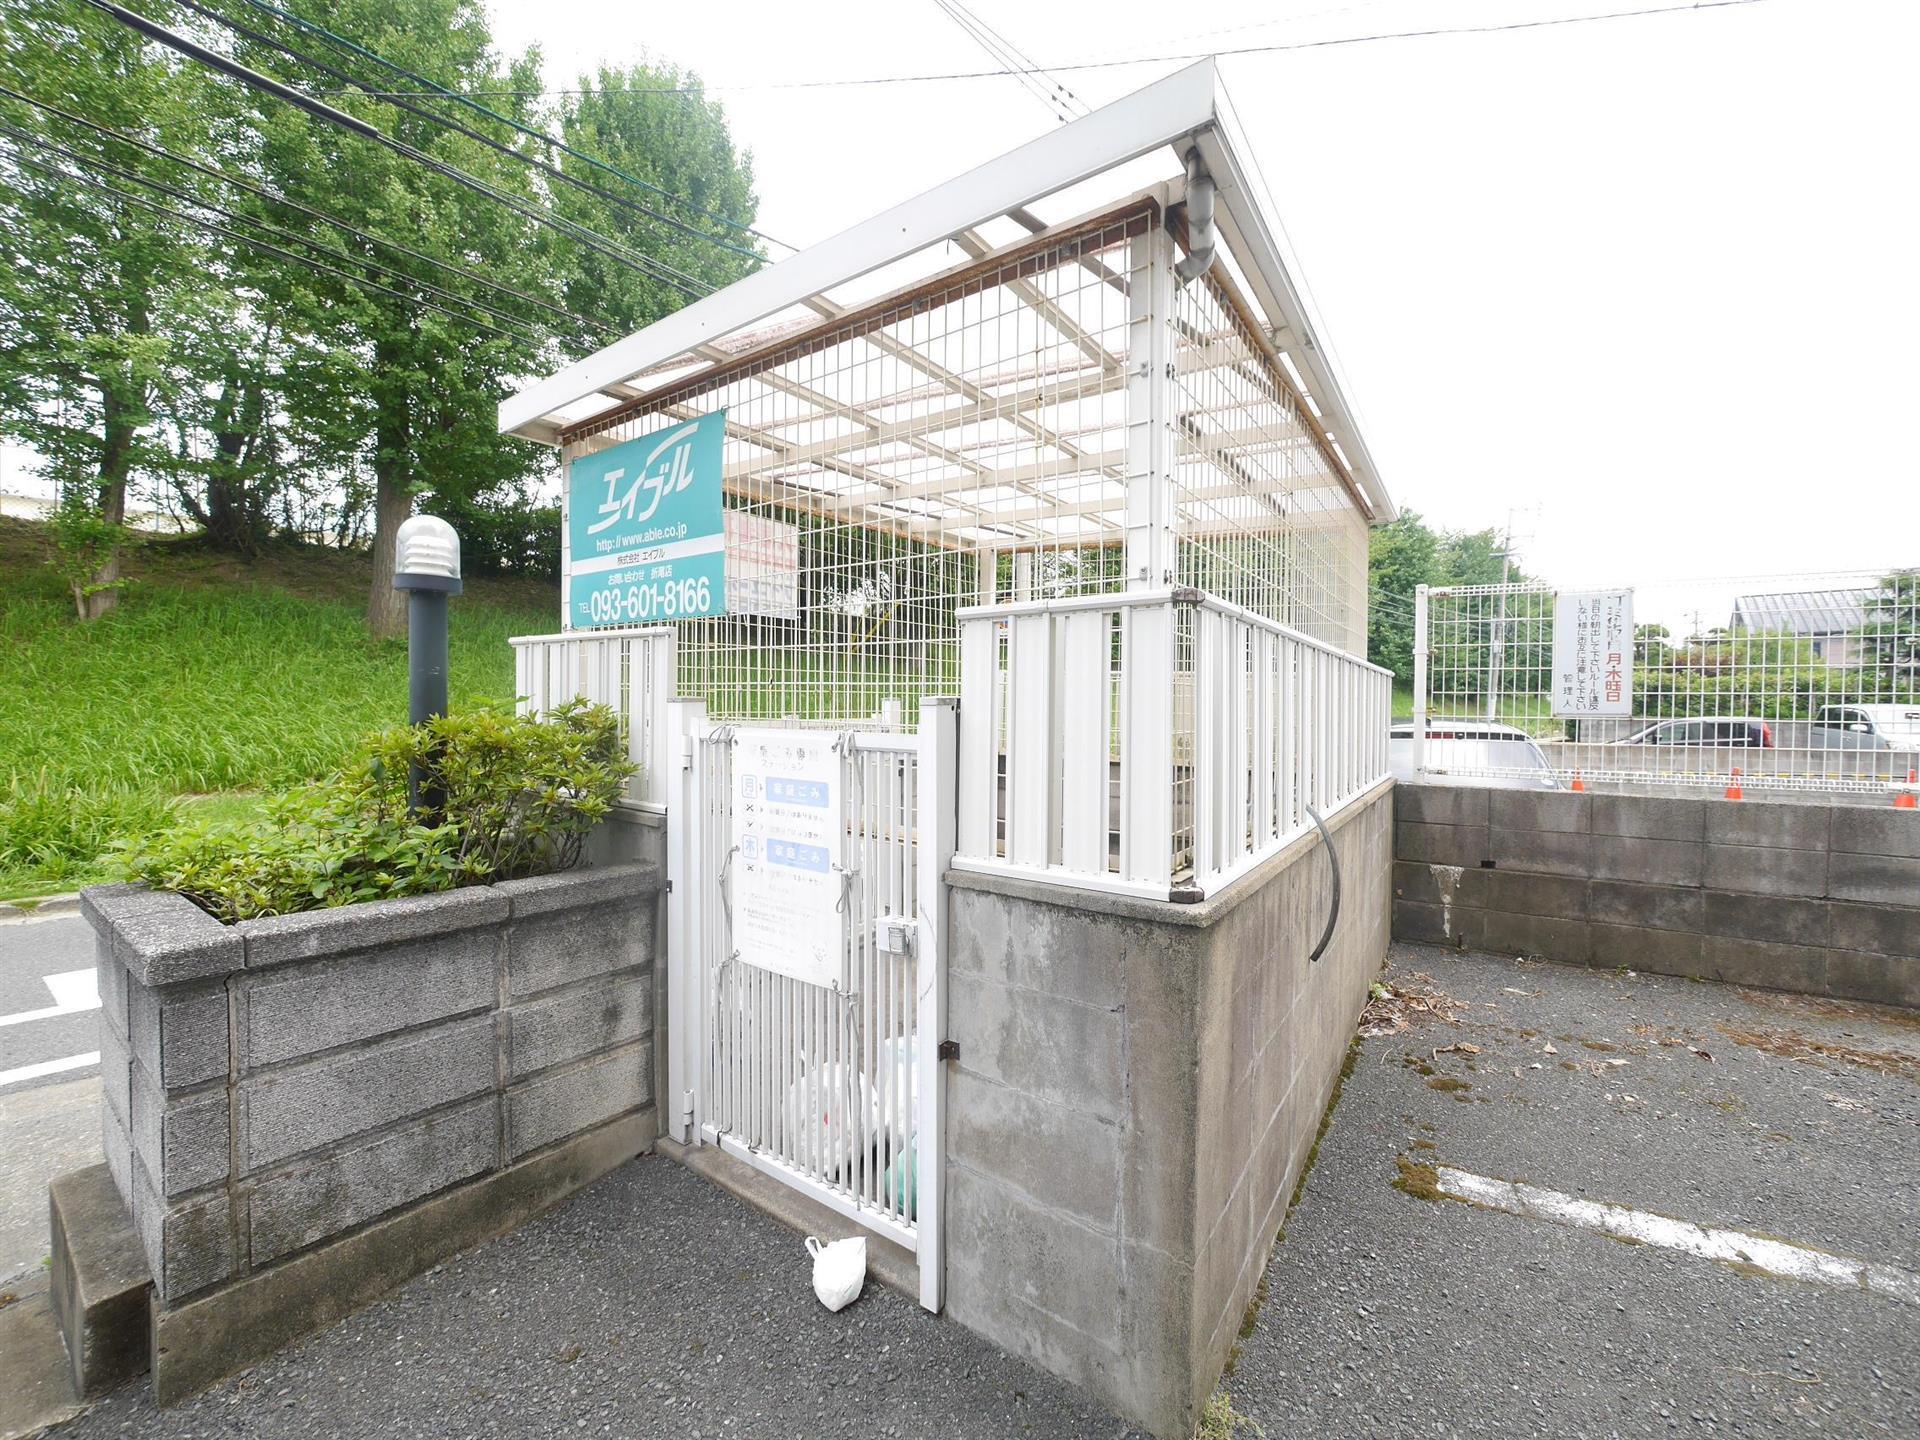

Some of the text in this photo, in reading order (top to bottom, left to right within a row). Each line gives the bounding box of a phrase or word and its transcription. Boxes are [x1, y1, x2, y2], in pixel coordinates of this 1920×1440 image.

[587, 422, 699, 535] エイブル
[595, 522, 688, 554] http://www.able.co.jp
[578, 576, 711, 622] TEL 093-601-8166
